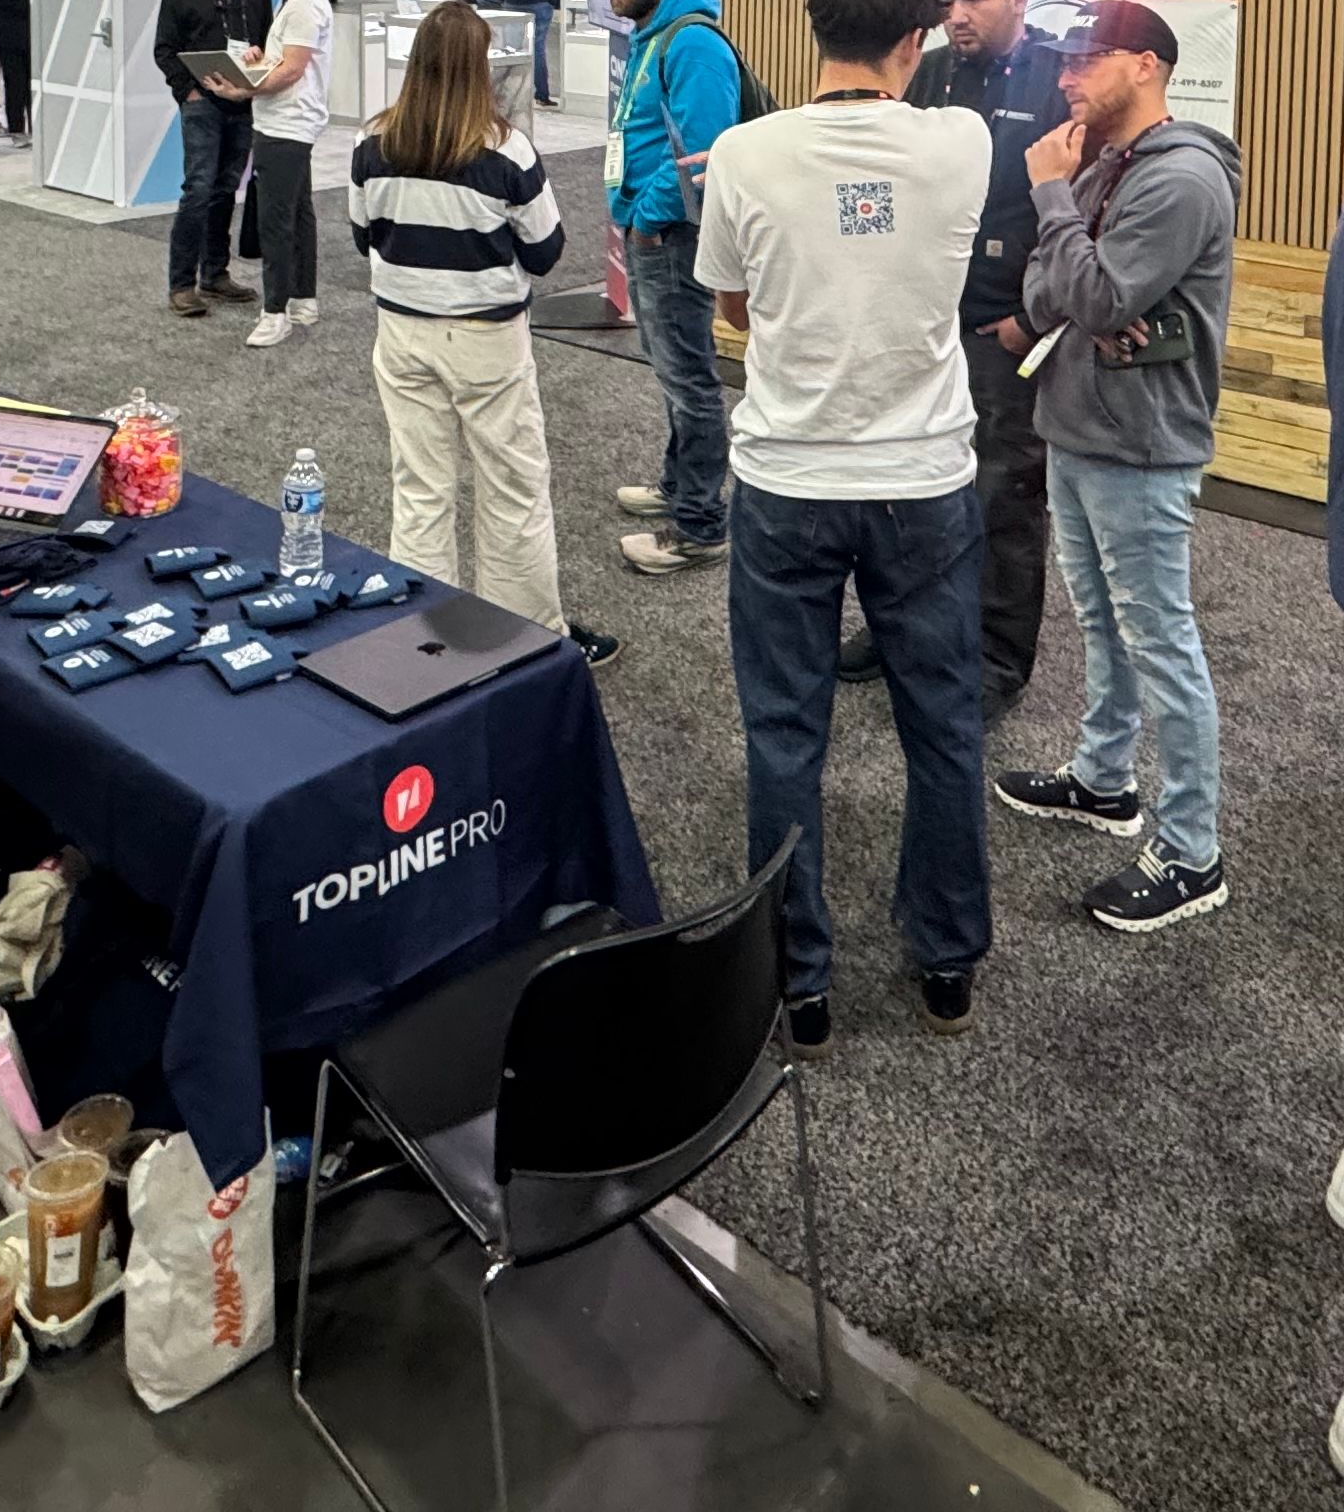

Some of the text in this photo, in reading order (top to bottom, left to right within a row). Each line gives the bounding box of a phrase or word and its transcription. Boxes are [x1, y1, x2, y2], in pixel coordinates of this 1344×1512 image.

[1168, 78, 1223, 89] 2-499-8307
[292, 799, 506, 924] TOPLINE PRO
